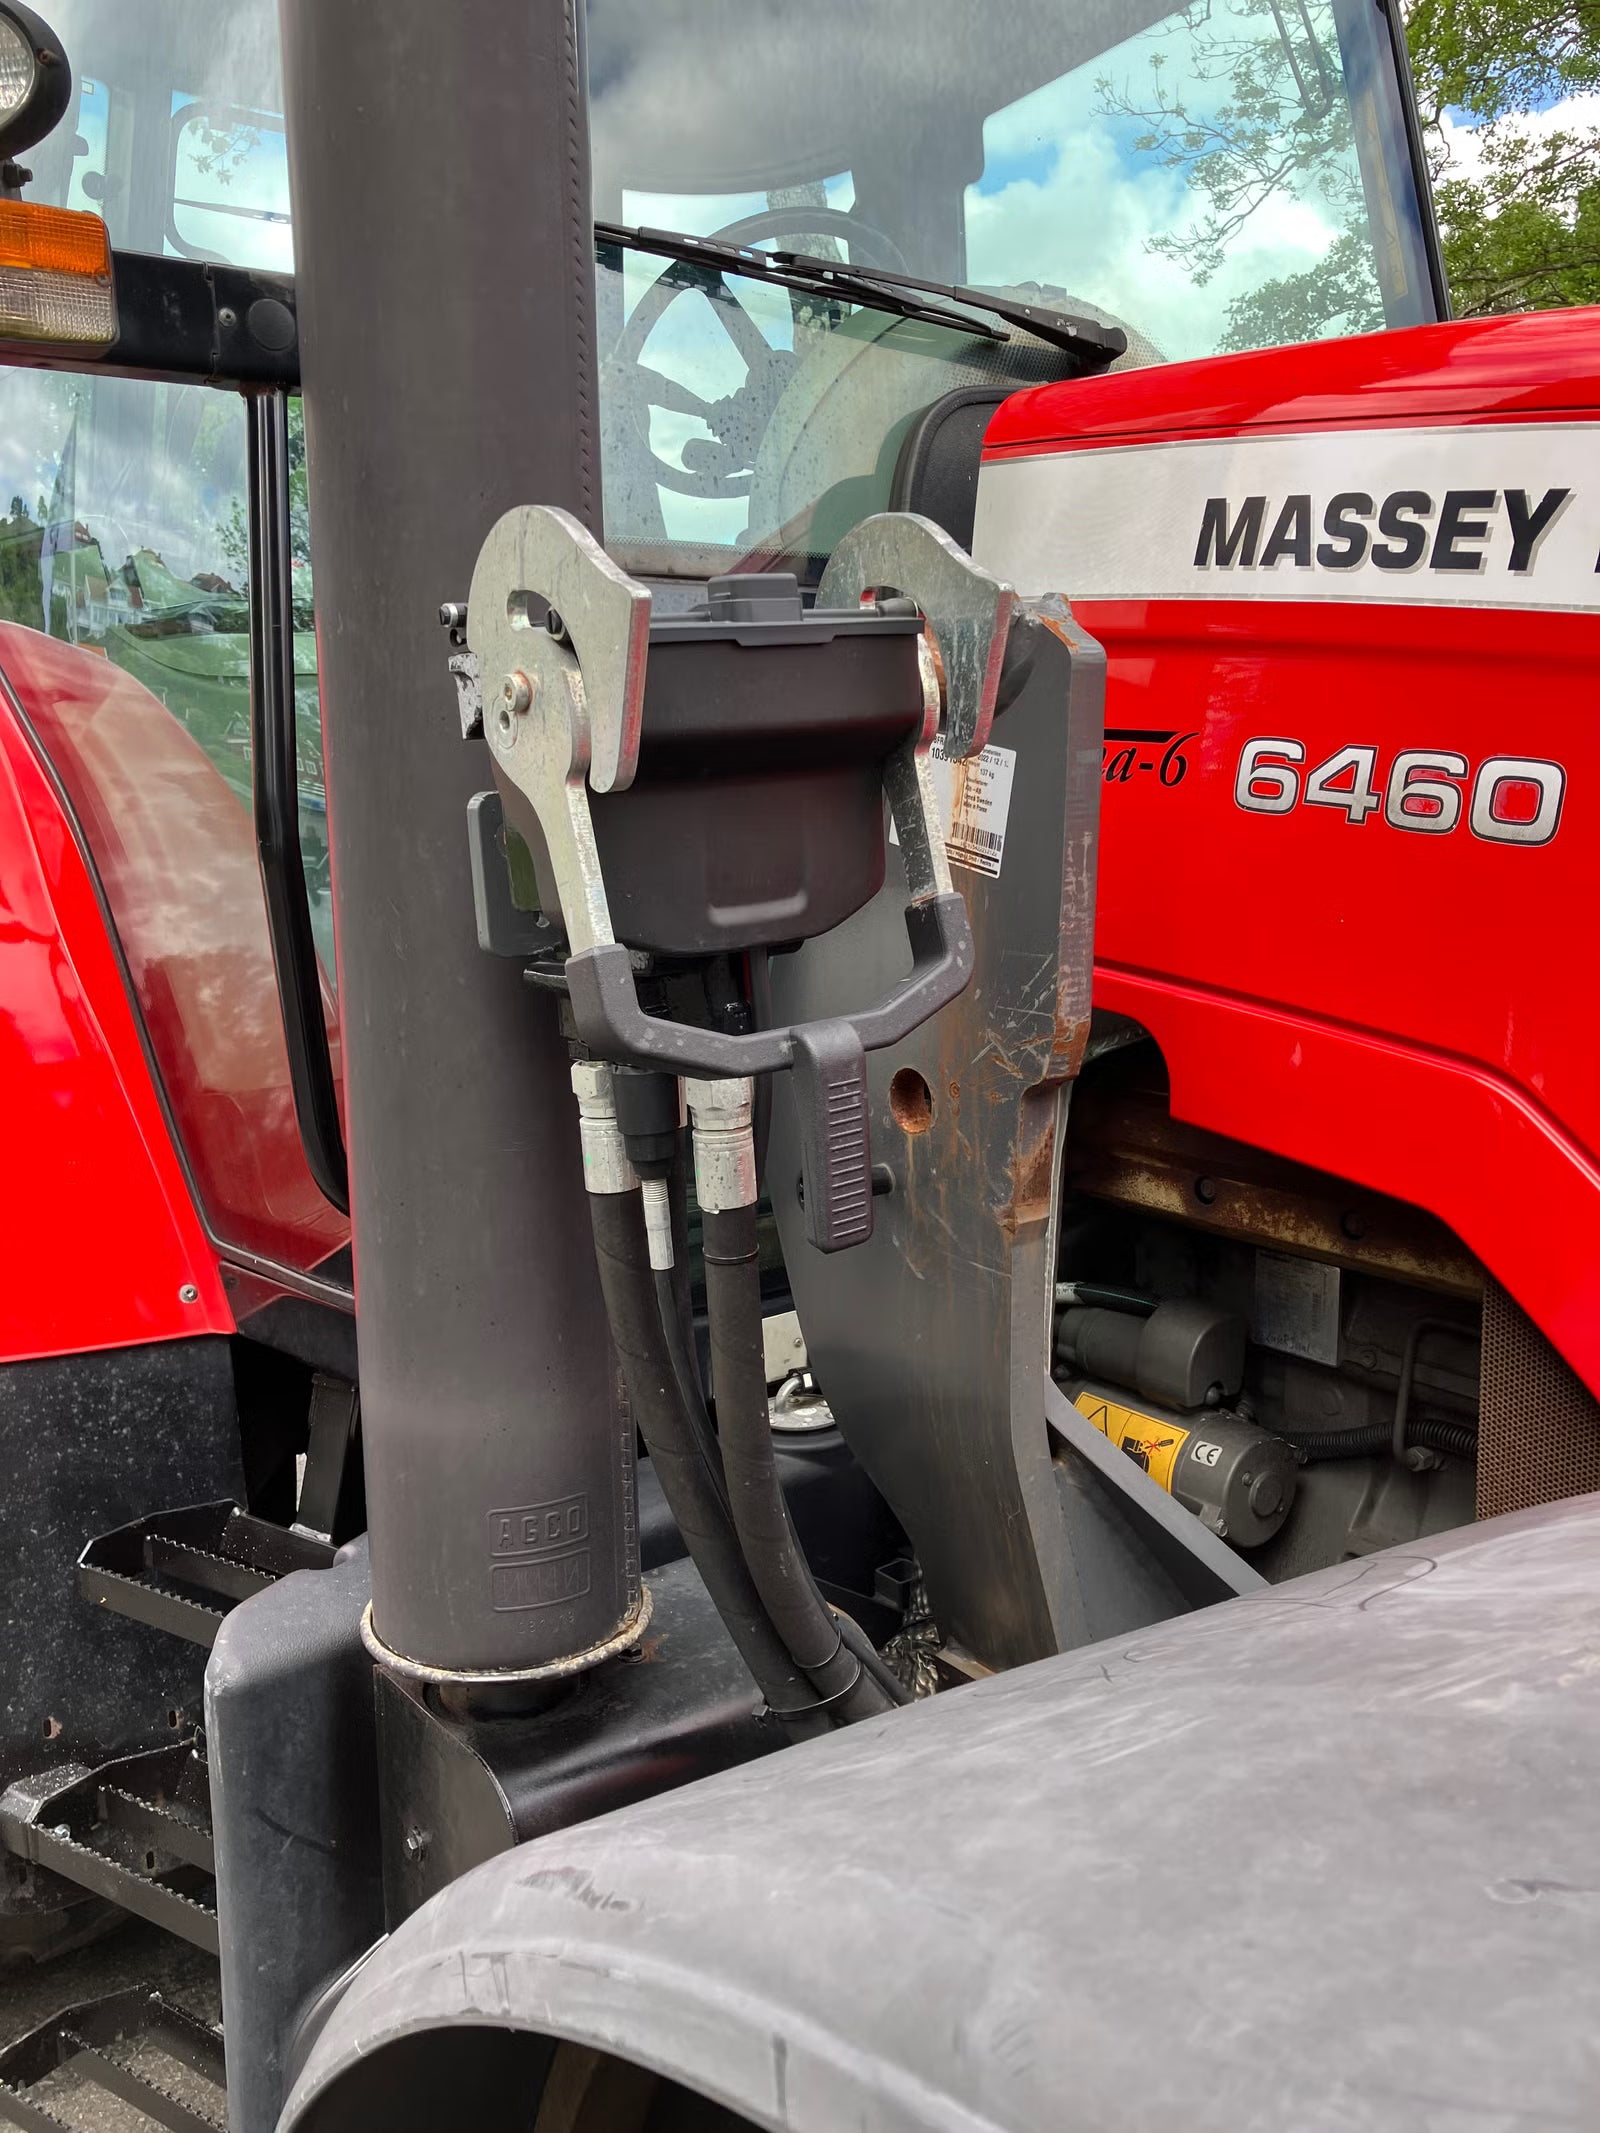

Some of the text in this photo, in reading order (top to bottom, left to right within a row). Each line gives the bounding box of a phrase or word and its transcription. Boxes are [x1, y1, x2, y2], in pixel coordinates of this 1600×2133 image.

[1193, 488, 1573, 574] MASSEY
[1102, 731, 1200, 788] a-6
[1233, 736, 1567, 848] 6460
[1194, 1444, 1220, 1465] CE
[499, 1505, 580, 1547] AGCO
